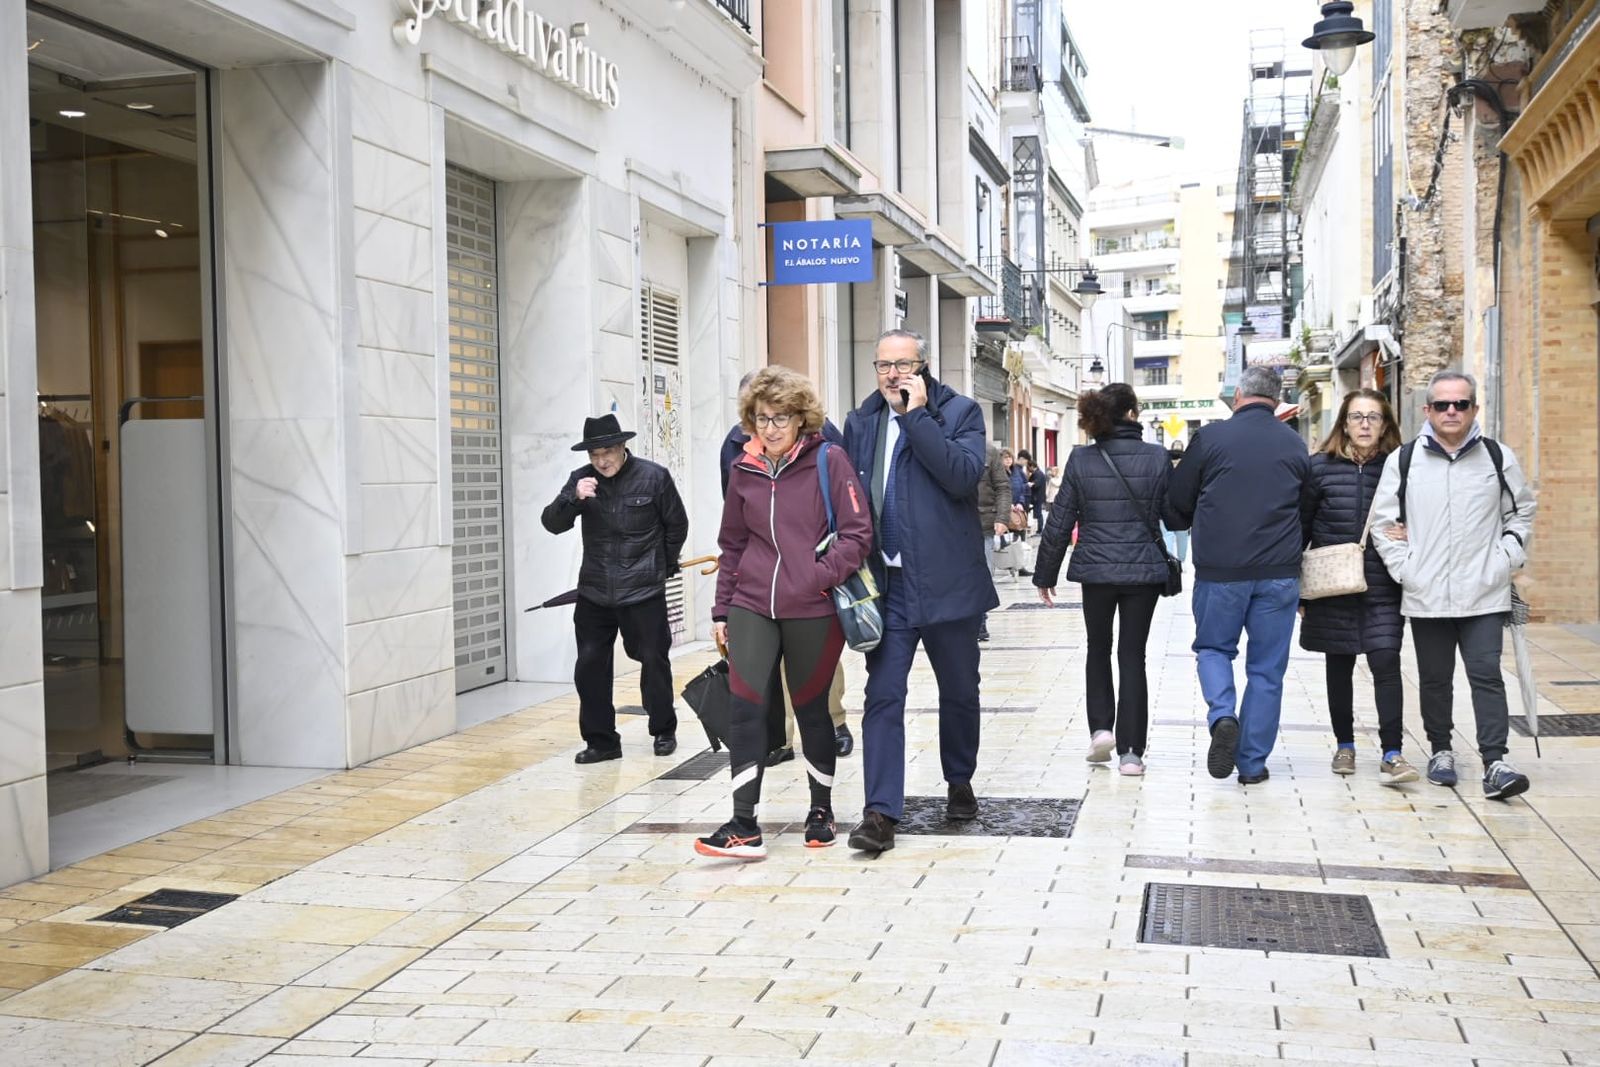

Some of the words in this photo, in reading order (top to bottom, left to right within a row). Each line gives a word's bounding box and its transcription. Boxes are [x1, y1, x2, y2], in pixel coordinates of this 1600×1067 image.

[783, 235, 861, 250] NOTARÍA
[796, 256, 827, 266] ÁBALOS
[830, 256, 860, 264] NUEVO
[1180, 400, 1196, 409] DEL
[1198, 399, 1215, 408] SUR
